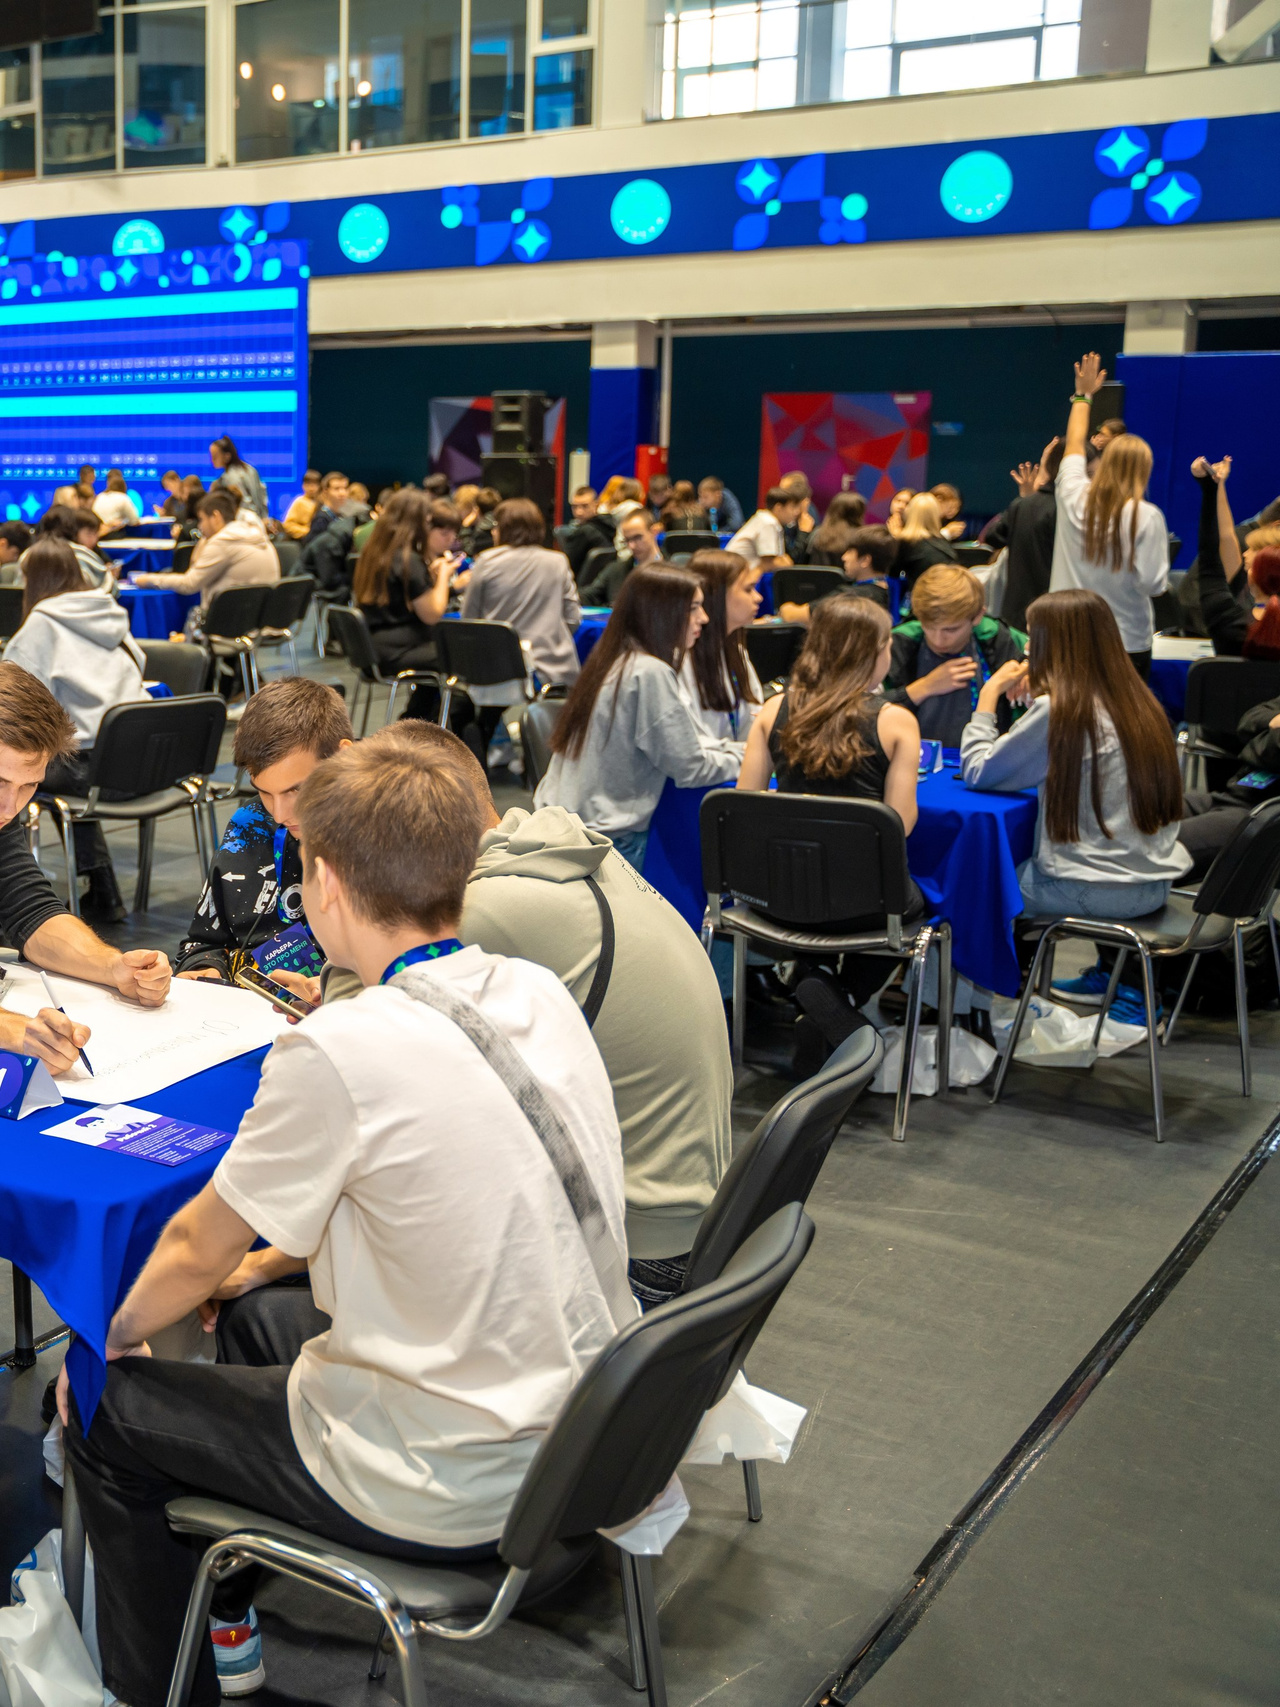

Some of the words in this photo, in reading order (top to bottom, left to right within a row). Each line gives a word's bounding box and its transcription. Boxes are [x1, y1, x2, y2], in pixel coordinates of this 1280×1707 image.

[263, 960, 277, 971] ЭТО
[275, 951, 290, 963] ПРО
[289, 940, 308, 955] МЕНЯ
[264, 941, 293, 962] КАРЬЕРА
